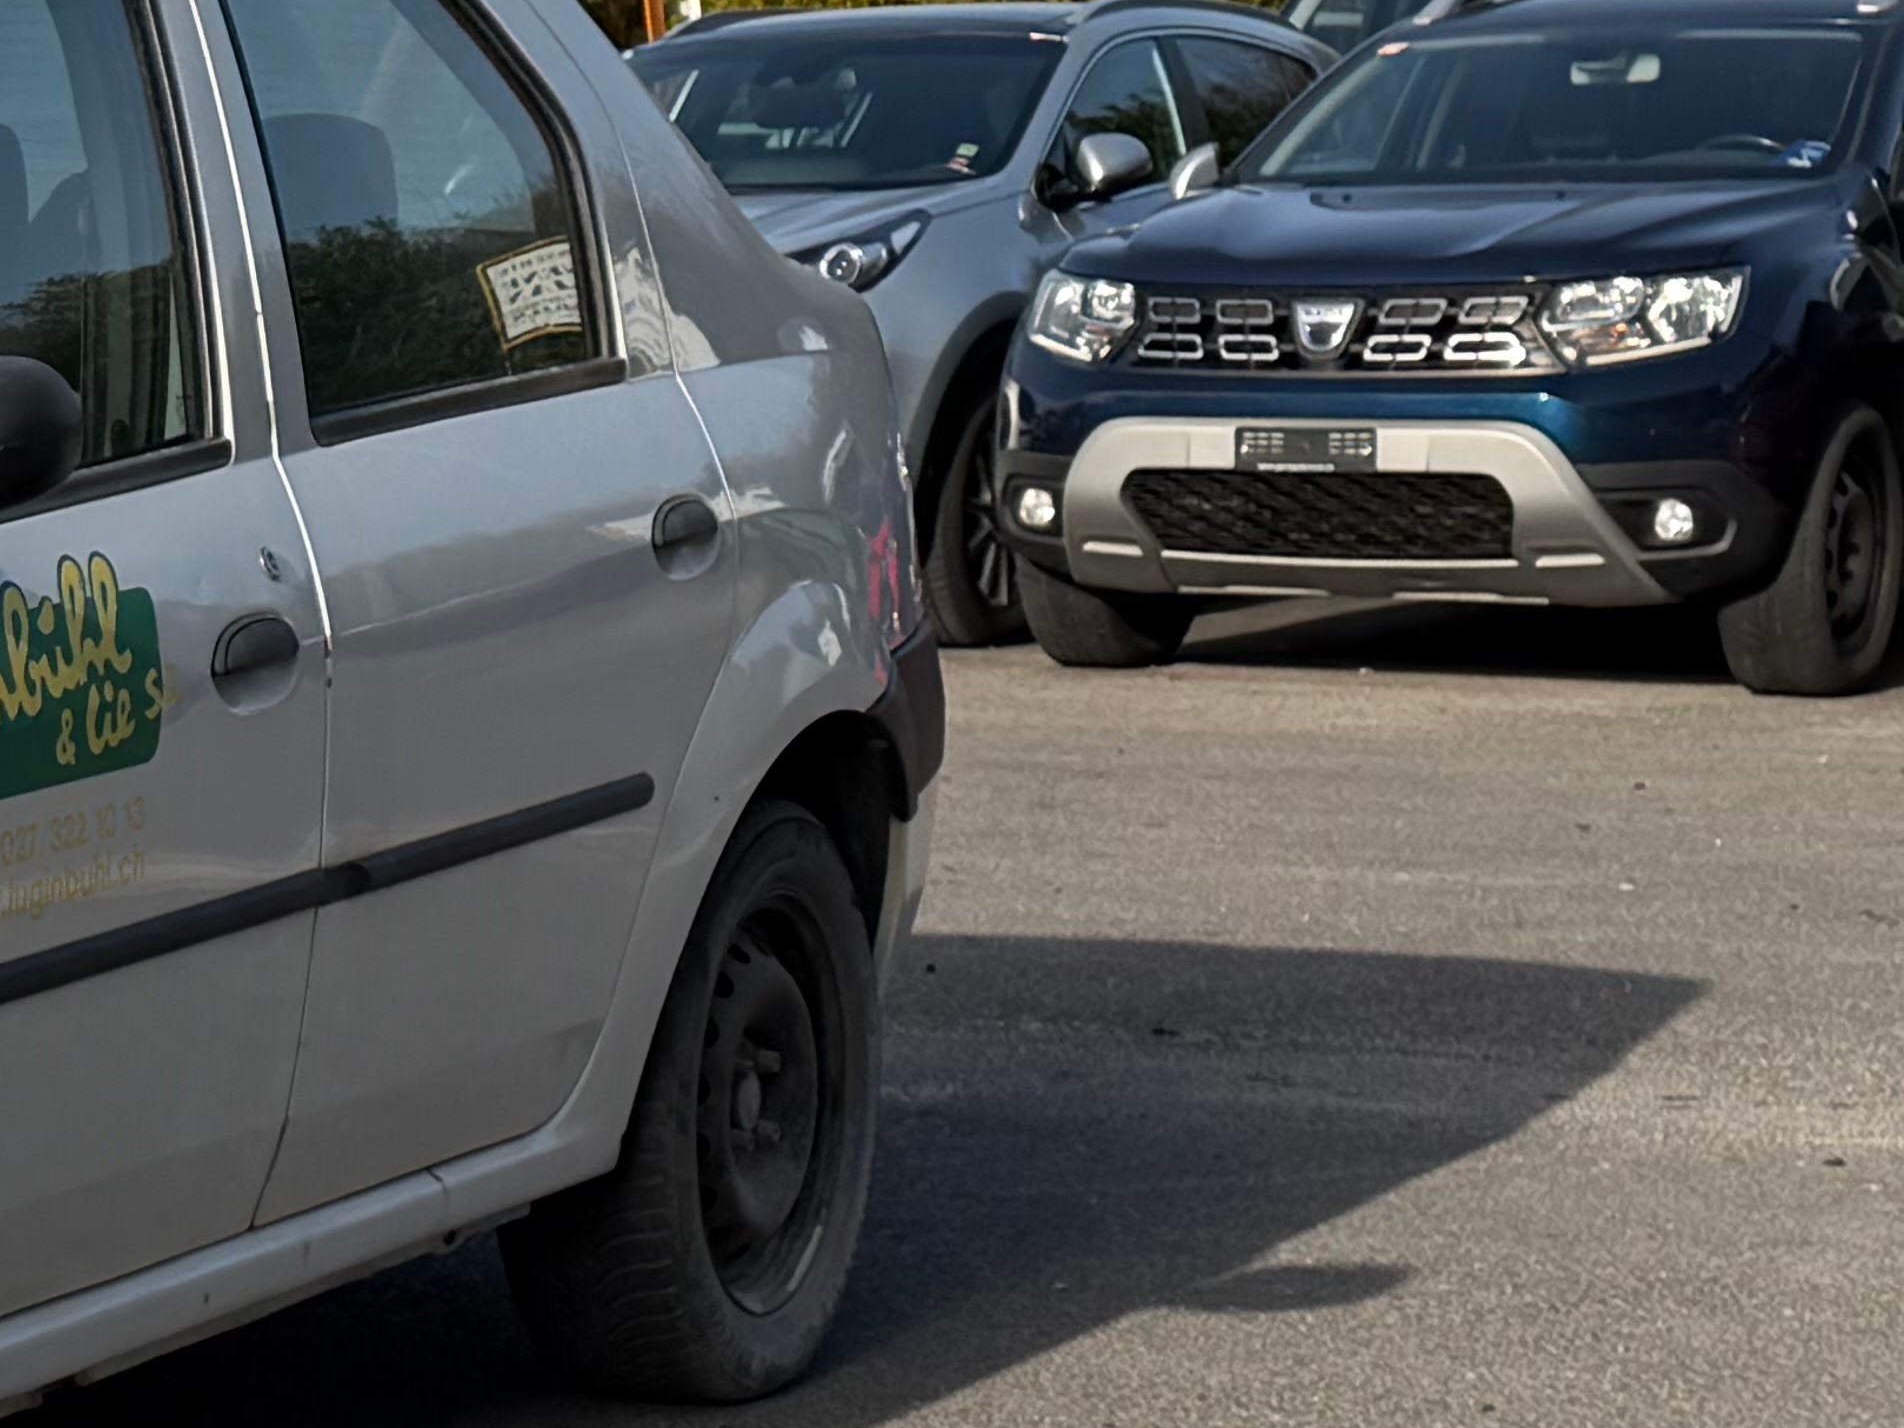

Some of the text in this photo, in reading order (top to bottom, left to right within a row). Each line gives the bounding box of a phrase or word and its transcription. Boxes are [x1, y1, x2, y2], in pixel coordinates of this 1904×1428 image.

[56, 707, 76, 765] &
[86, 682, 136, 755] Cie
[96, 801, 117, 839] 10
[124, 795, 146, 832] 13
